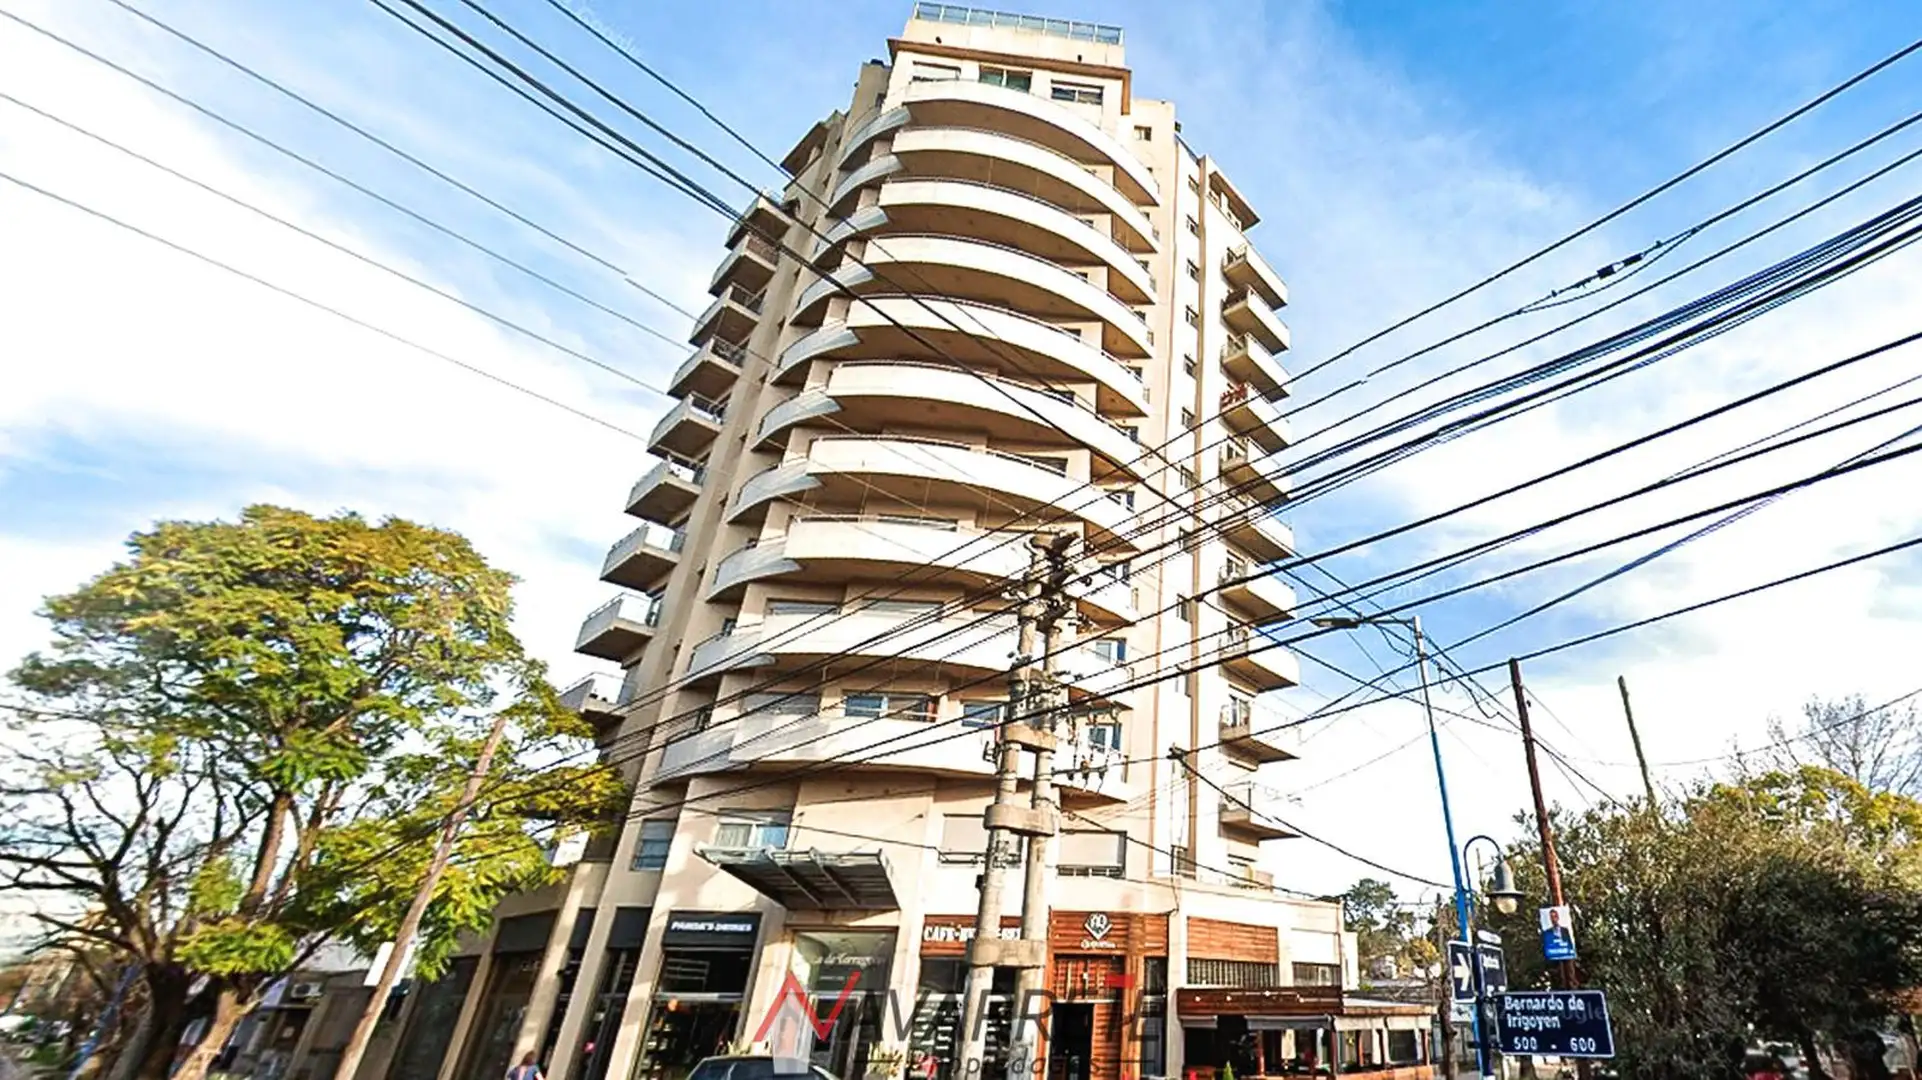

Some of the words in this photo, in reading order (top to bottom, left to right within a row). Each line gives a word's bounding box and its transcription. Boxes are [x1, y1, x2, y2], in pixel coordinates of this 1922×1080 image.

[1504, 993, 1564, 1011] Bernardo
[1568, 993, 1585, 1011] de
[1506, 1013, 1561, 1031] Irigoyen
[1513, 1036, 1538, 1050] 500
[1570, 1037, 1596, 1052] 600
